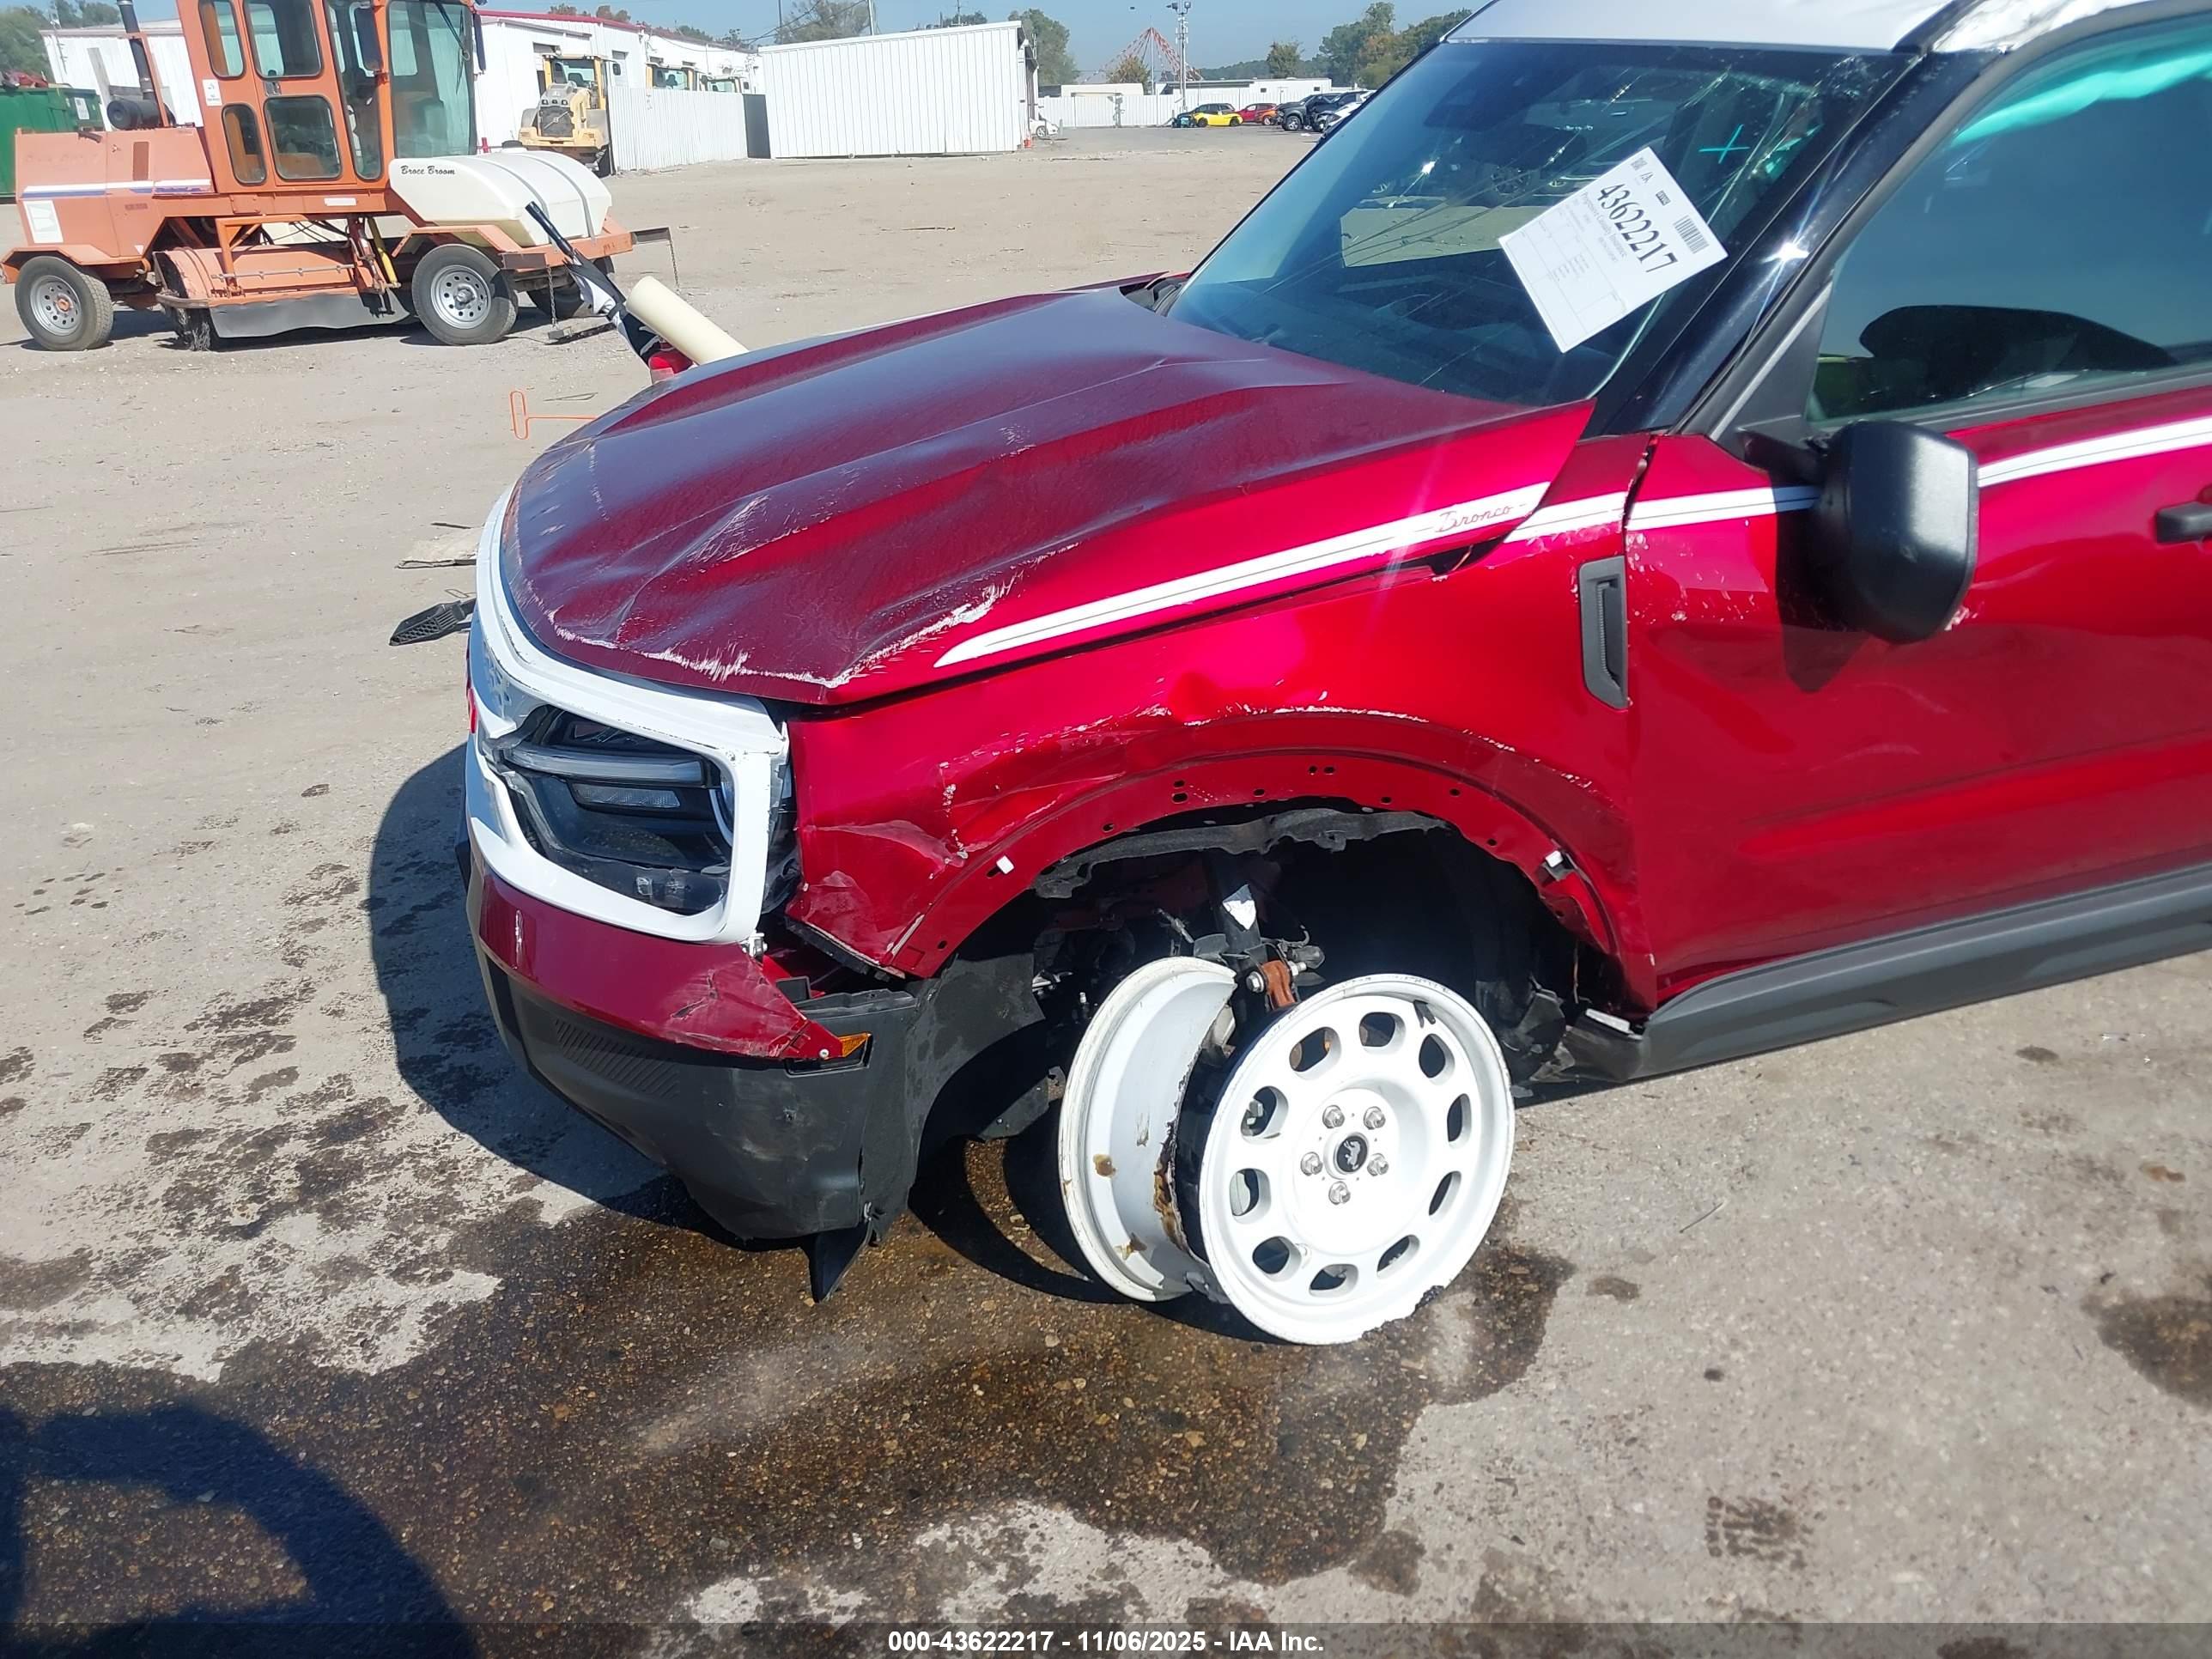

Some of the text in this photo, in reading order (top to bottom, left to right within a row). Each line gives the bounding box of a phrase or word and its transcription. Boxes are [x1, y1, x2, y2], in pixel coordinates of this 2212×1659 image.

[400, 165, 456, 175] Broce Broom
[1597, 183, 1679, 273] 43622217
[1435, 505, 1514, 533] Bronco
